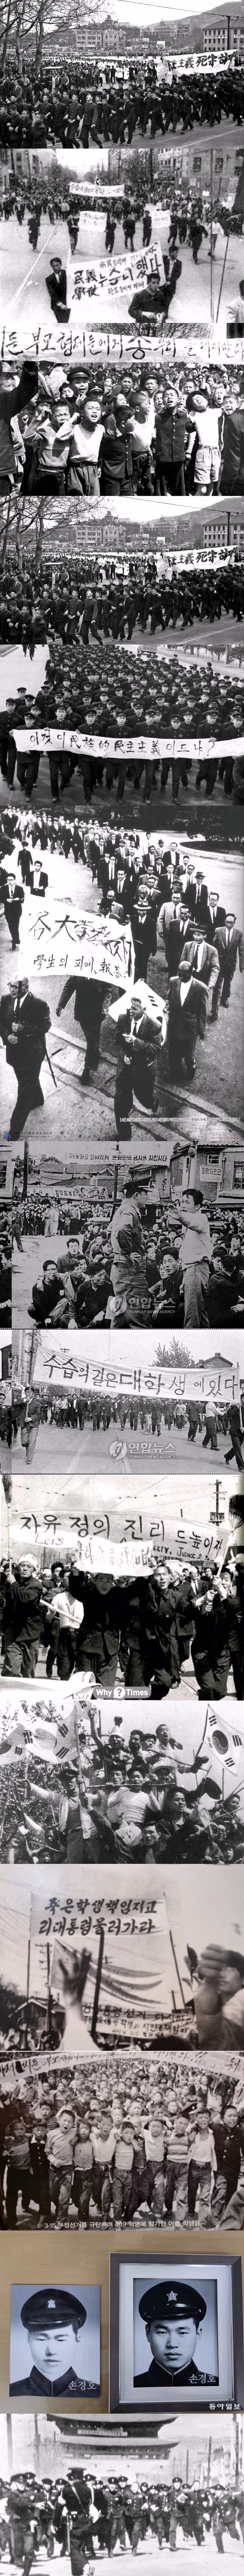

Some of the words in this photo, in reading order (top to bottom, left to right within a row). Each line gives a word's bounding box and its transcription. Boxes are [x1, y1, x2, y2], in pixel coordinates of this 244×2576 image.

[202, 1167, 222, 1175] 희망사진관
[20, 1514, 61, 1535] 자유
[69, 1514, 110, 1539] 정의
[124, 1515, 165, 1541] 진리
